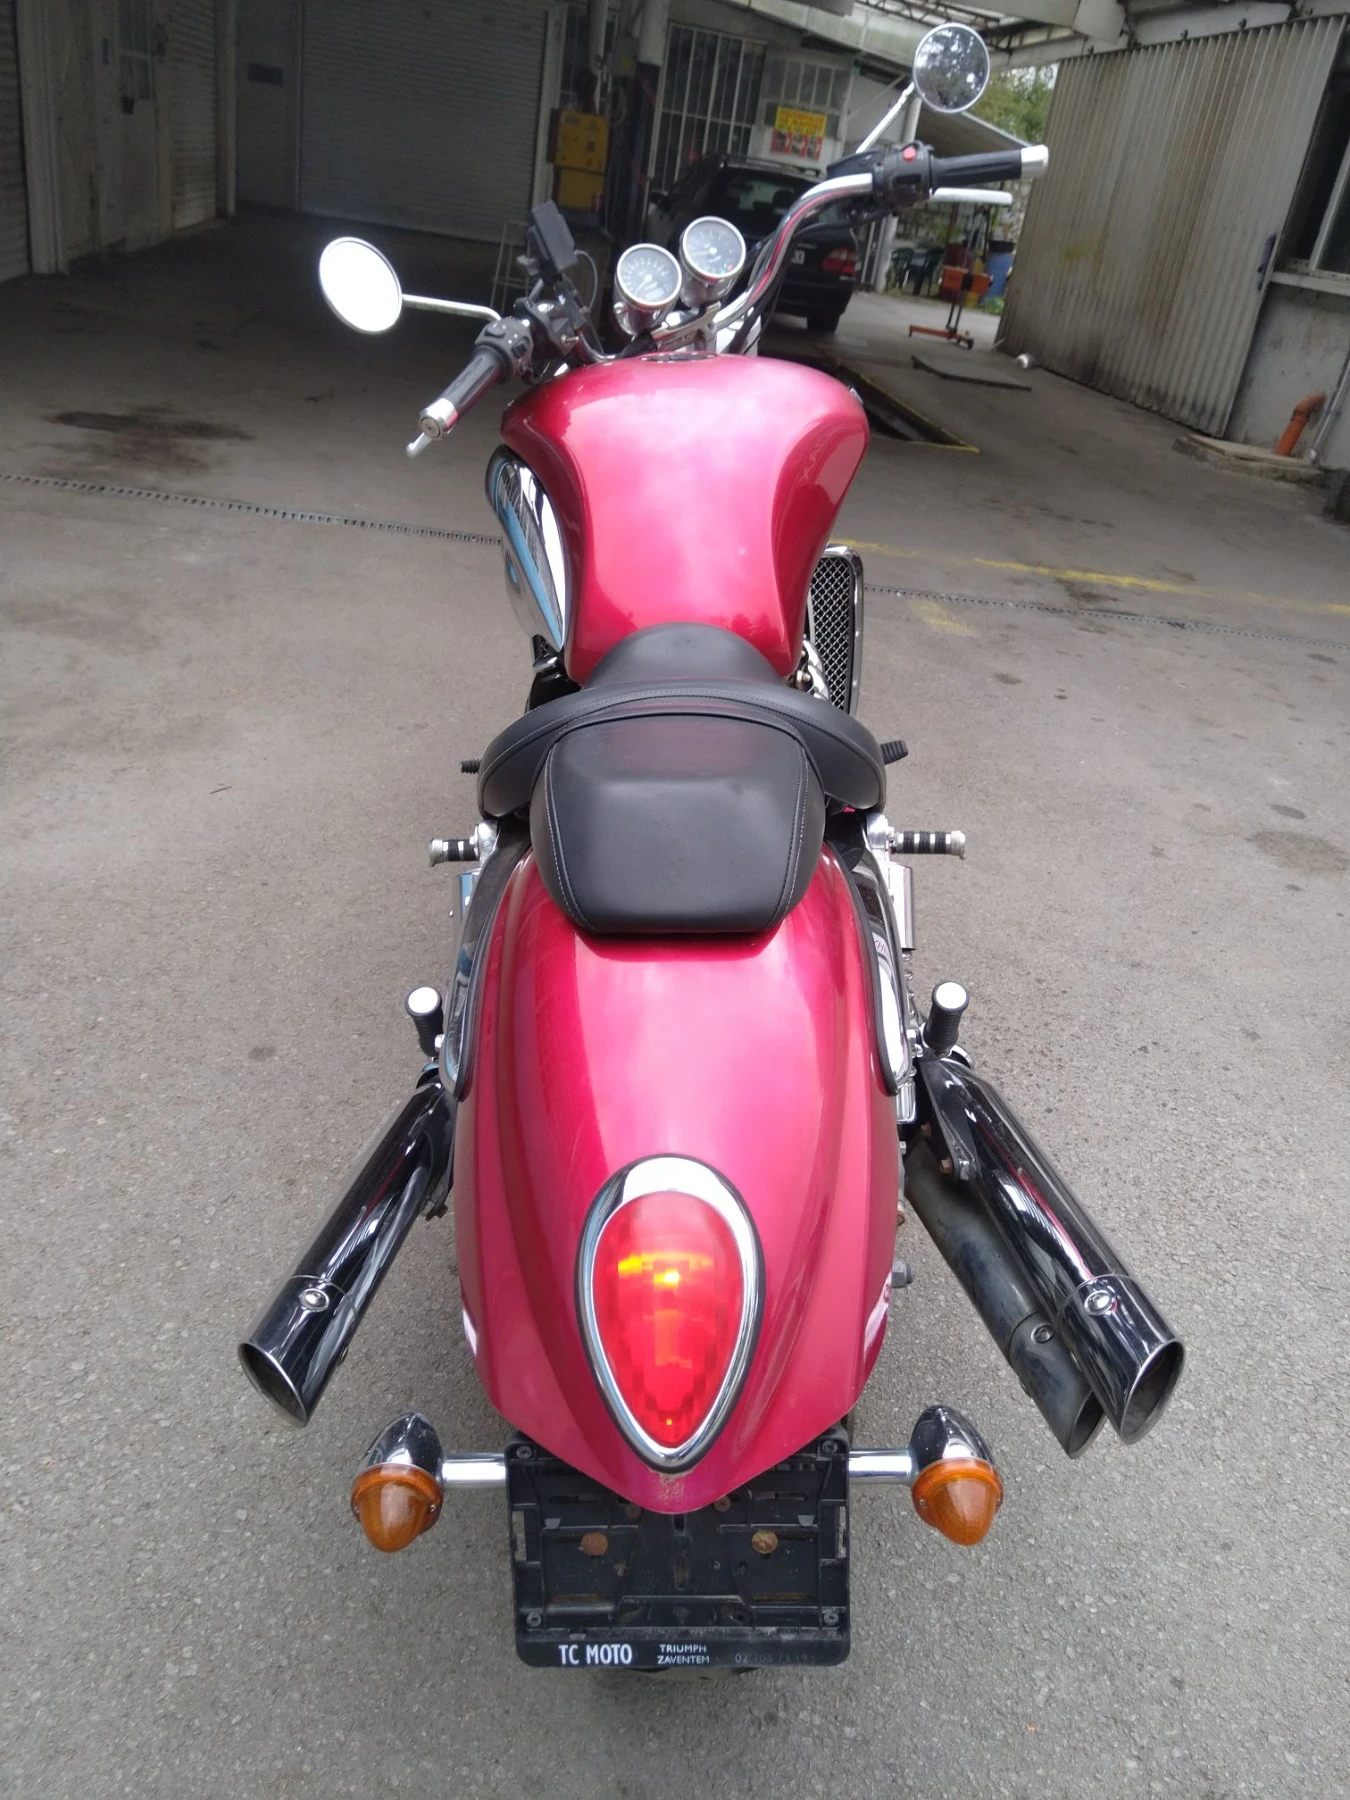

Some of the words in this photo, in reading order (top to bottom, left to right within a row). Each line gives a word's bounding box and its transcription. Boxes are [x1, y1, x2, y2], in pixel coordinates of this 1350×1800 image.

[659, 1644, 707, 1654] TRIUMPH
[558, 1644, 579, 1665] TC
[586, 1644, 633, 1665] MOTO
[657, 1655, 710, 1665] ZAVENTEM
